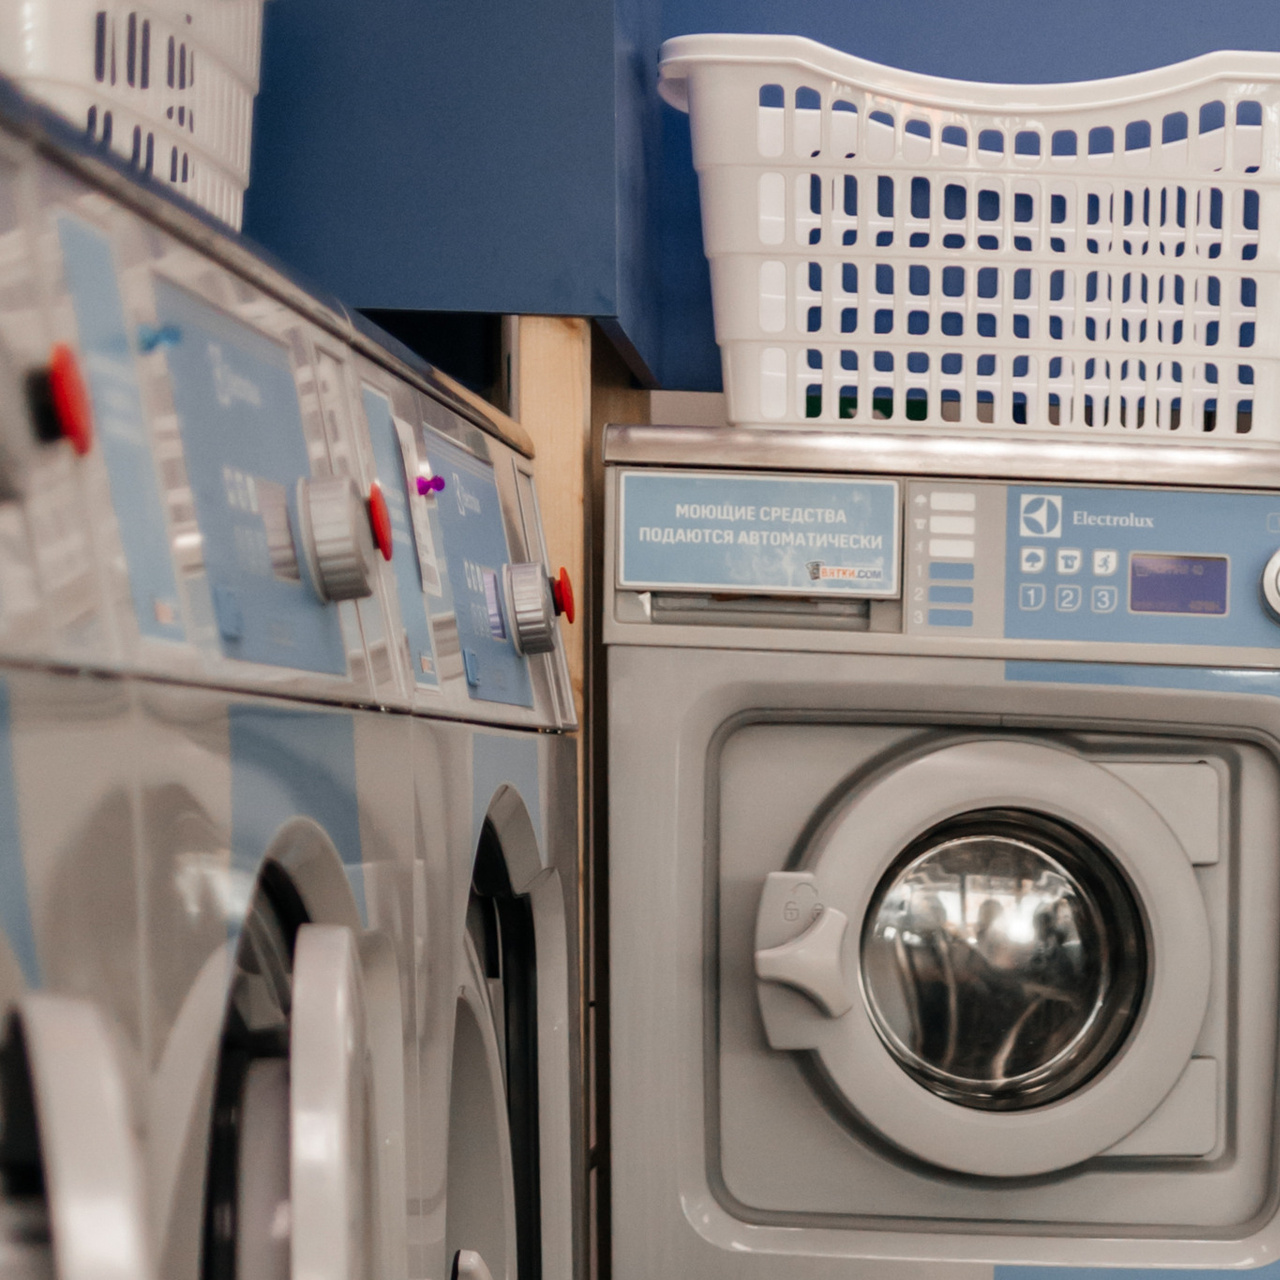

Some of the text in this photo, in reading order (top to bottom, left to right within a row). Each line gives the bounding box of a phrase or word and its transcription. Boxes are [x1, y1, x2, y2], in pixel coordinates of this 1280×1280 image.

[675, 503, 847, 523] МОЮЩИЕ СРЕДСТВА
[1072, 510, 1154, 528] Electrolux
[639, 527, 883, 550] ПОДАЮТСЯ АВТОМАТИЧЕСКИ
[1027, 588, 1110, 609] 1 2 3
